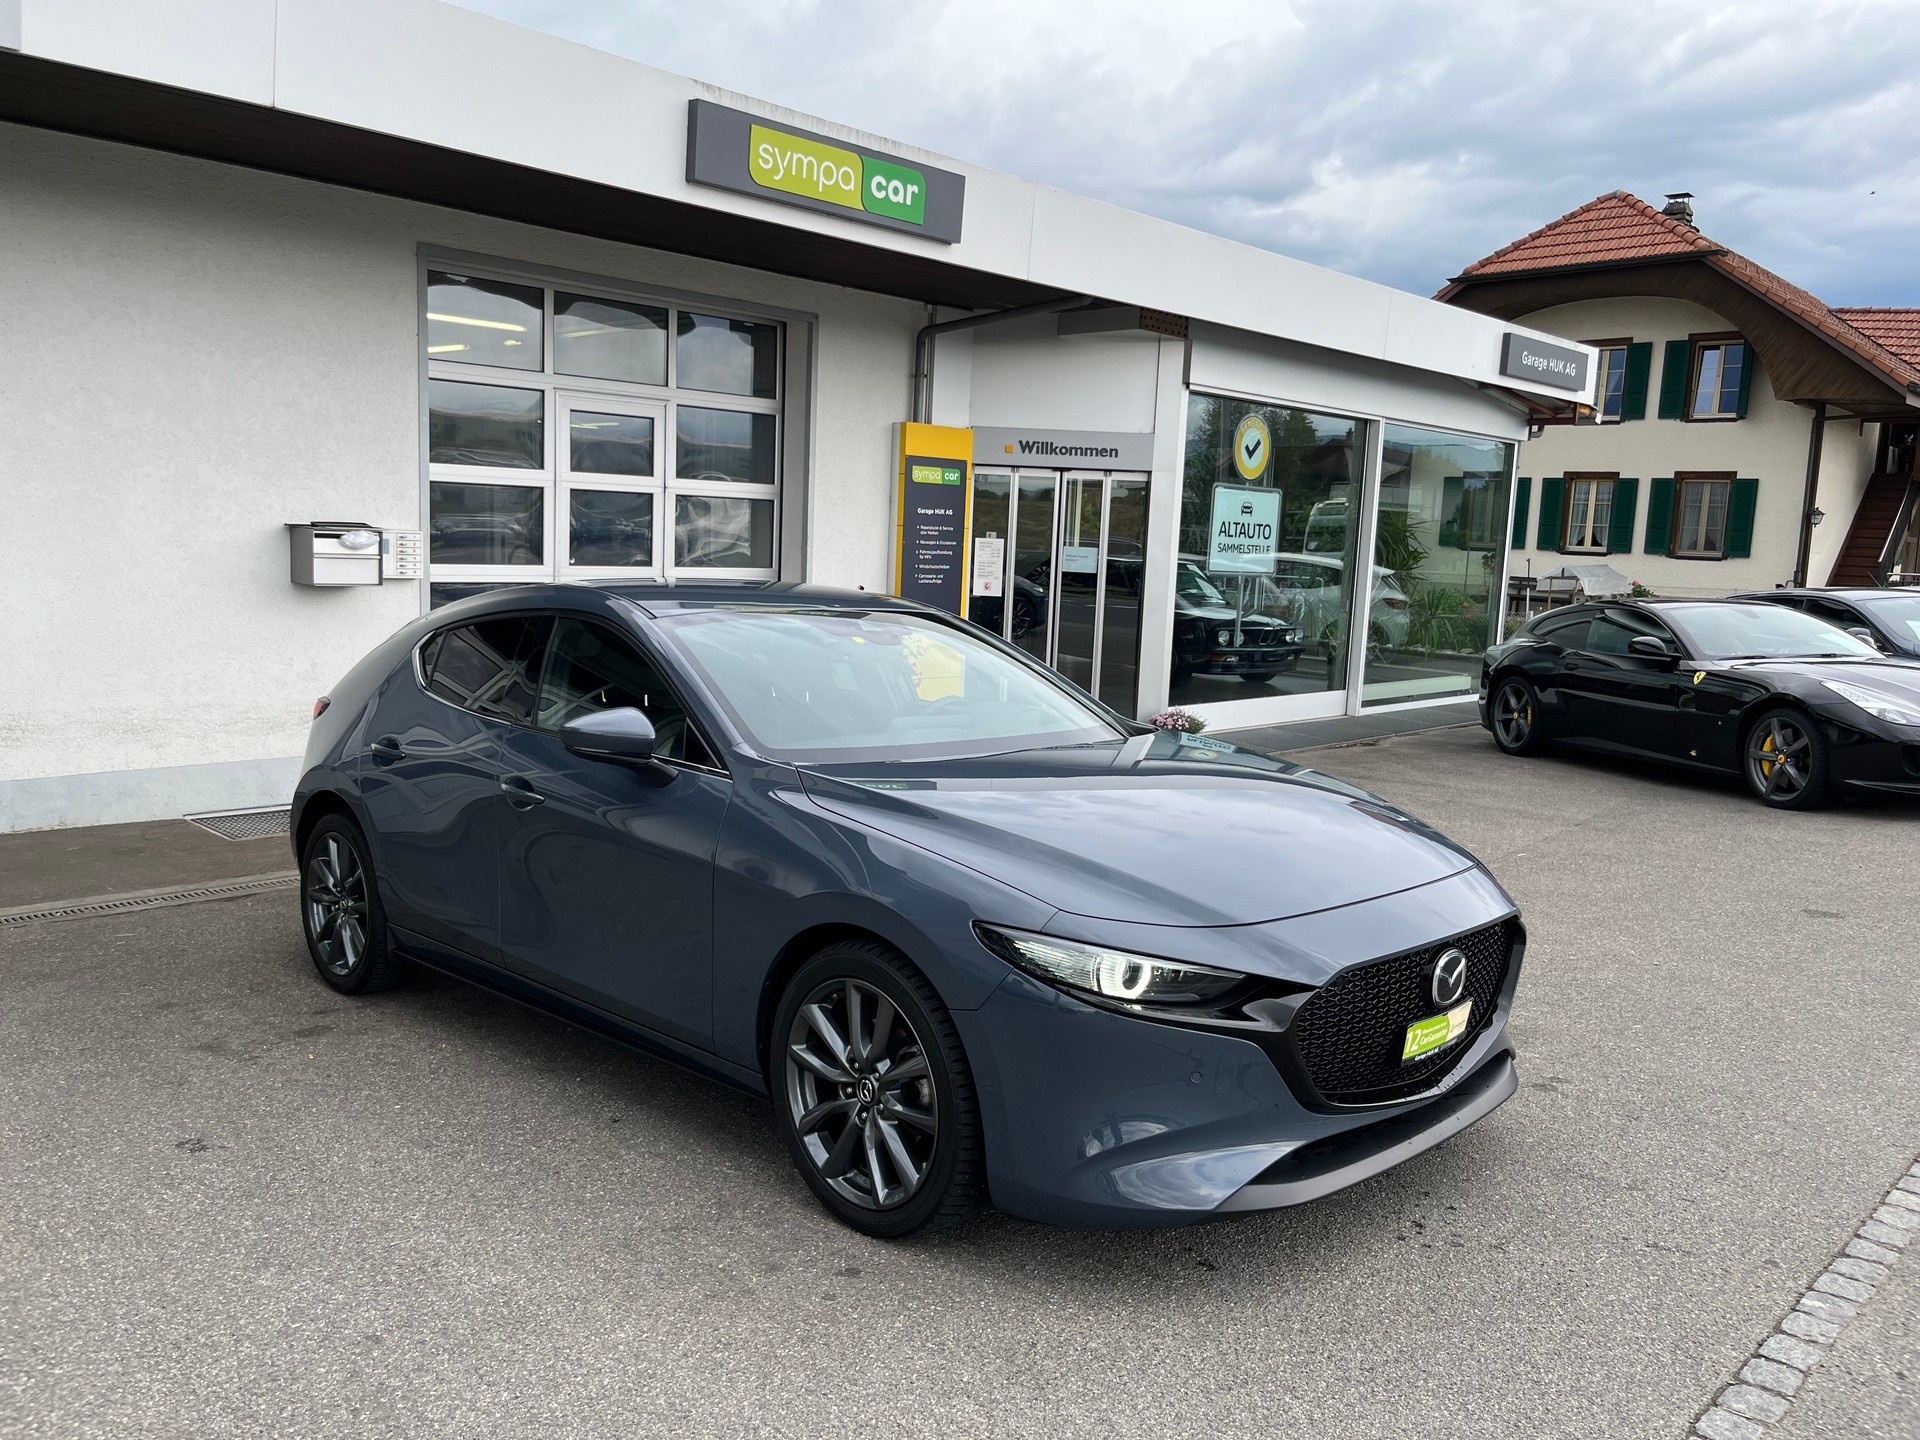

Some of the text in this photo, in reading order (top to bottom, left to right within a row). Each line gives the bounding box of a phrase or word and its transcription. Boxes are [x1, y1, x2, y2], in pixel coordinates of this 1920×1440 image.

[758, 143, 919, 206] sympa car
[1522, 351, 1576, 377] Garage HUK AG
[1018, 440, 1119, 458] Willkommen
[914, 470, 959, 481] sympa car
[917, 507, 934, 516] Garage
[1218, 520, 1272, 540] ALTAUTO
[1217, 542, 1271, 555] SAMMELSTELLE
[1406, 1029, 1422, 1054] 12
